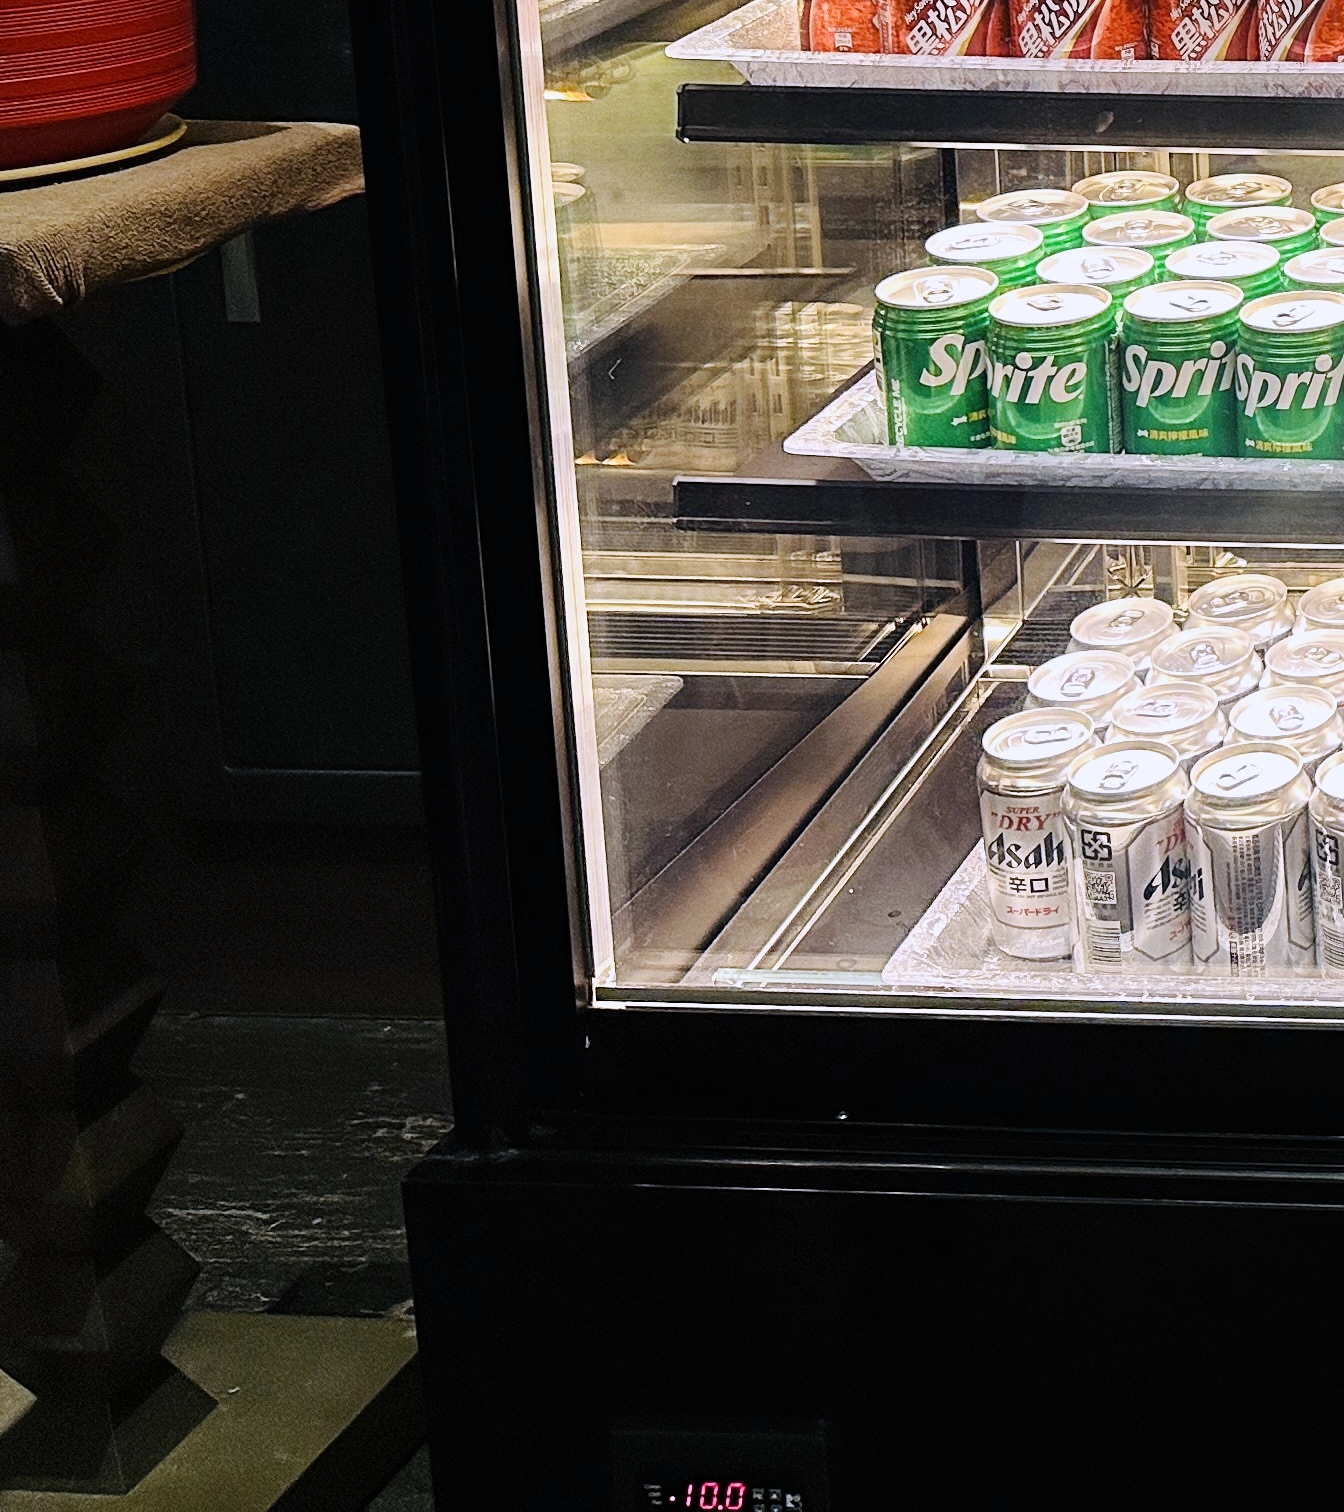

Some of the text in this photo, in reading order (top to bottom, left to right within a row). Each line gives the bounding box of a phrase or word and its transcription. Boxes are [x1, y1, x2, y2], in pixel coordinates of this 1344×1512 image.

[992, 352, 1087, 404] rite
[1122, 341, 1234, 407] Sprit
[890, 379, 900, 397] ME
[1004, 805, 1040, 813] SUPER
[987, 832, 1065, 869] Asah
[1009, 876, 1049, 893] 辛口
[1005, 905, 1060, 916] スーパードライ
